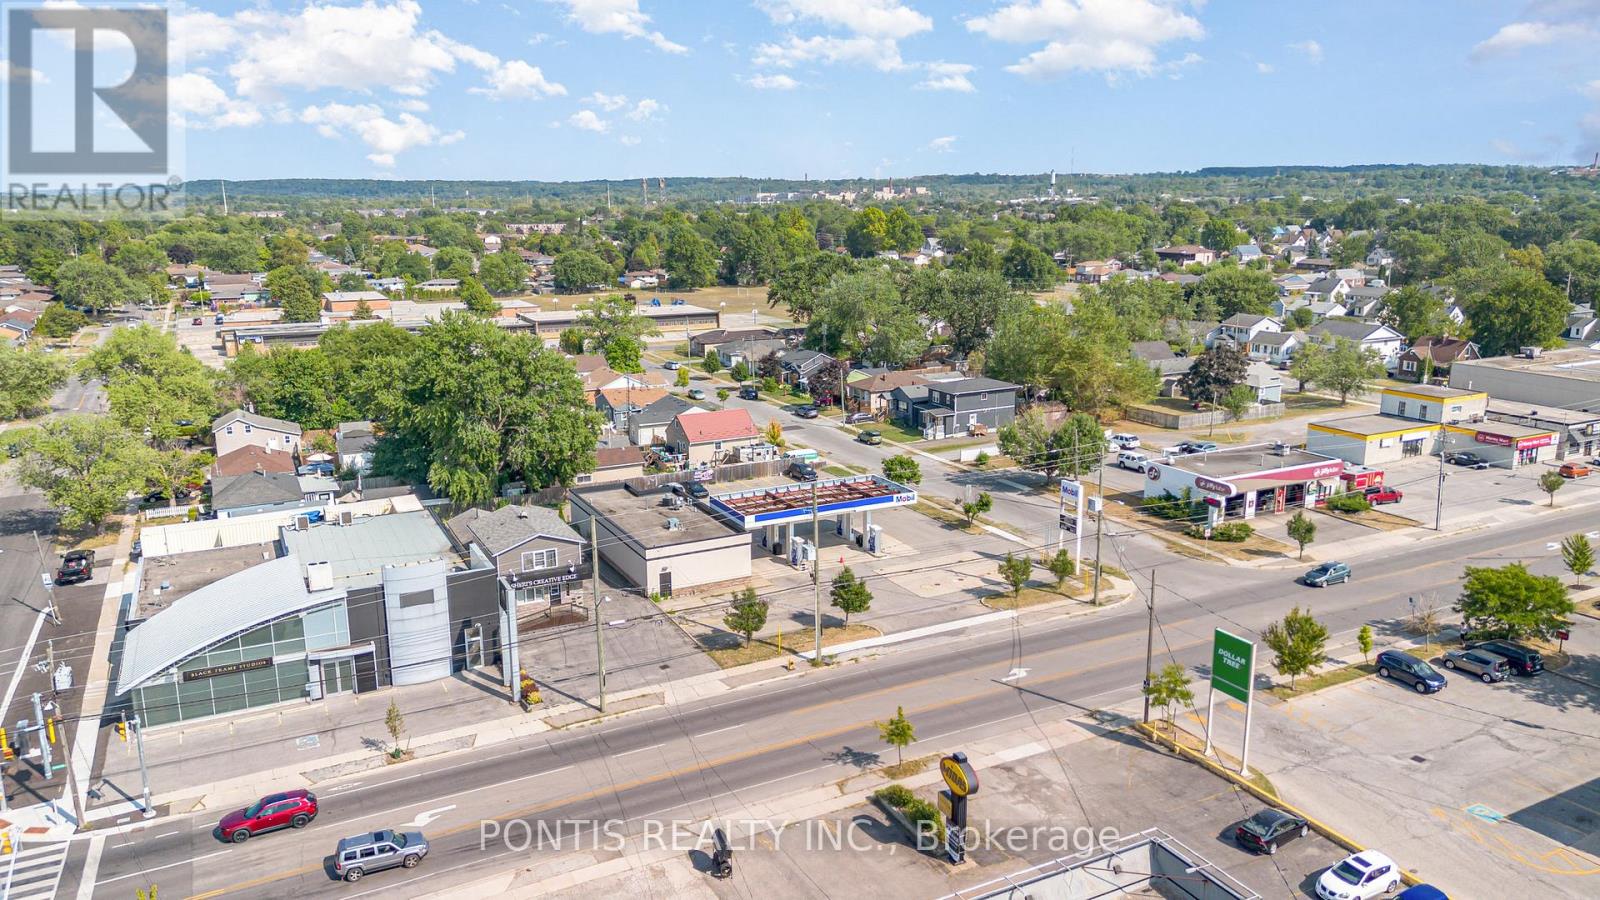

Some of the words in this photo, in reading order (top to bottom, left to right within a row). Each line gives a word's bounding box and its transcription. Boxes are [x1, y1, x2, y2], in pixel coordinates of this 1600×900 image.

[895, 493, 915, 503] Mobil
[1062, 485, 1079, 498] Mobil
[533, 576, 561, 585] CREATIVE
[562, 573, 578, 582] EDGE
[1218, 648, 1246, 665] DOLLAR
[1223, 656, 1241, 670] TREE
[190, 669, 213, 678] BLACK
[215, 665, 237, 674] FRAME
